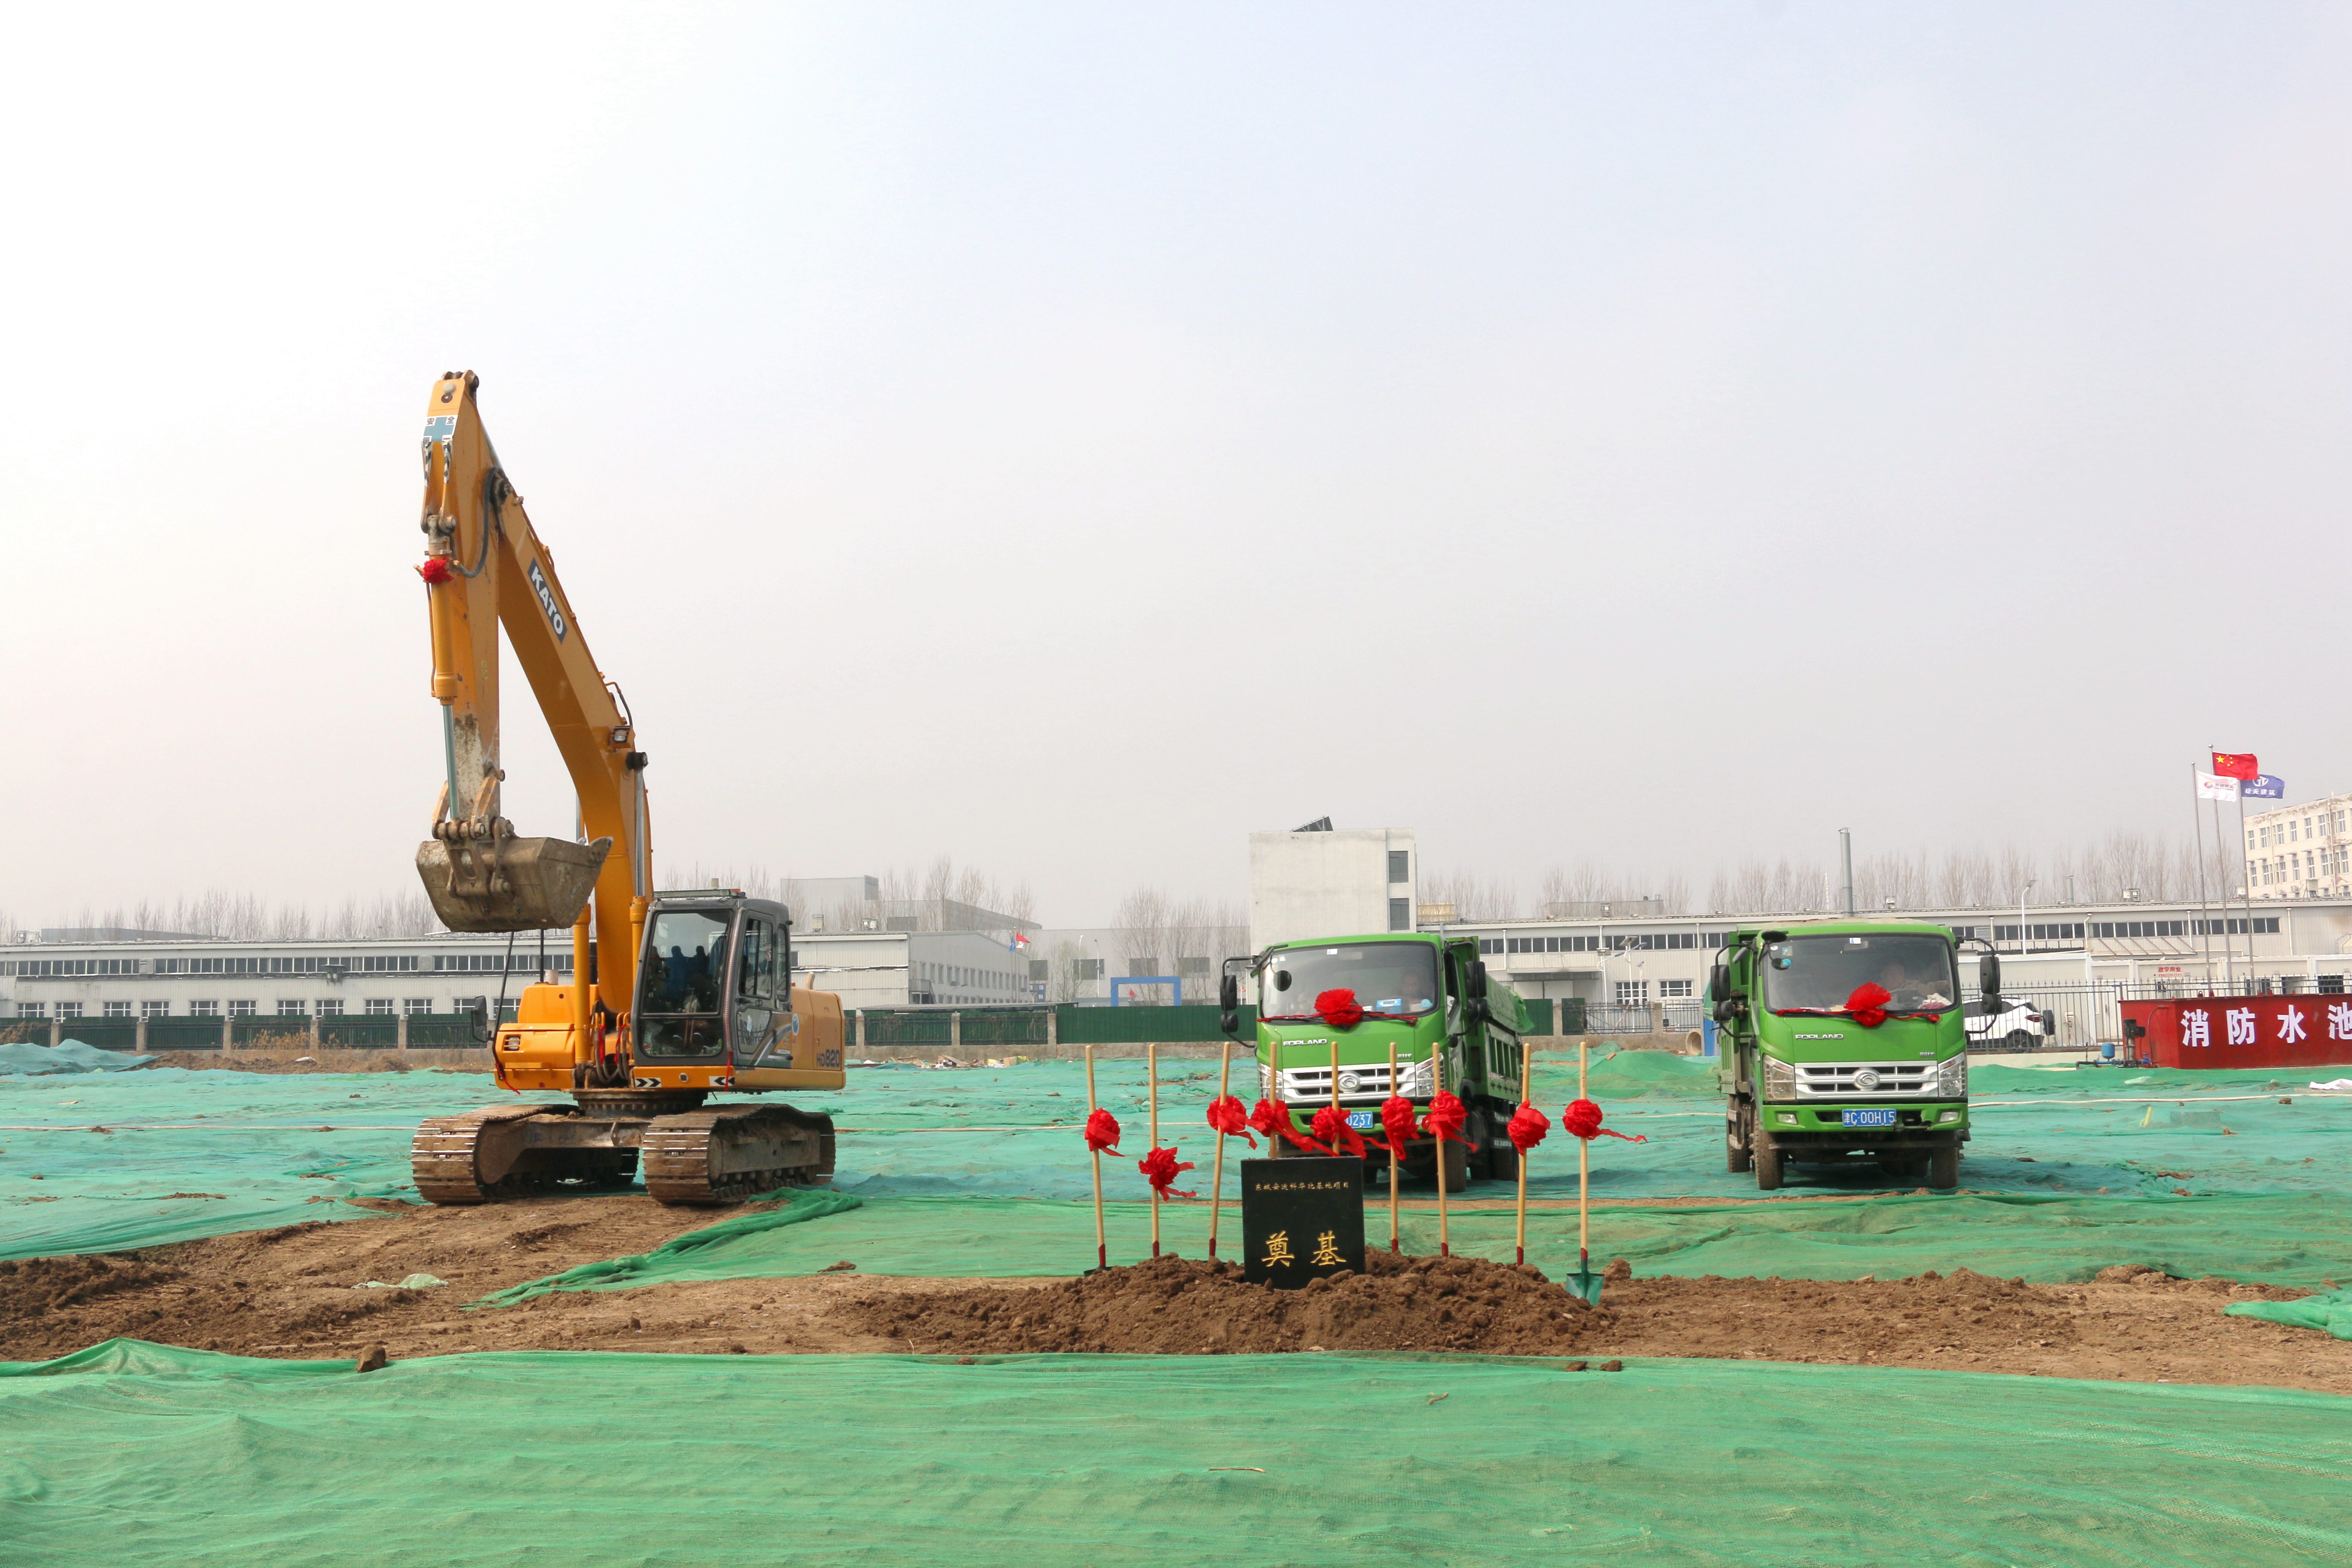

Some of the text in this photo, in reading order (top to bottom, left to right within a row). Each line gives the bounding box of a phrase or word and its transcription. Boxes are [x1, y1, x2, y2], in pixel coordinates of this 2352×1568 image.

[531, 566, 563, 634] KATO
[2180, 1002, 2352, 1047] 消防水池
[816, 1049, 840, 1068] HD820
[1344, 1114, 1372, 1126] 0237
[1261, 1230, 1347, 1267] 奠基
